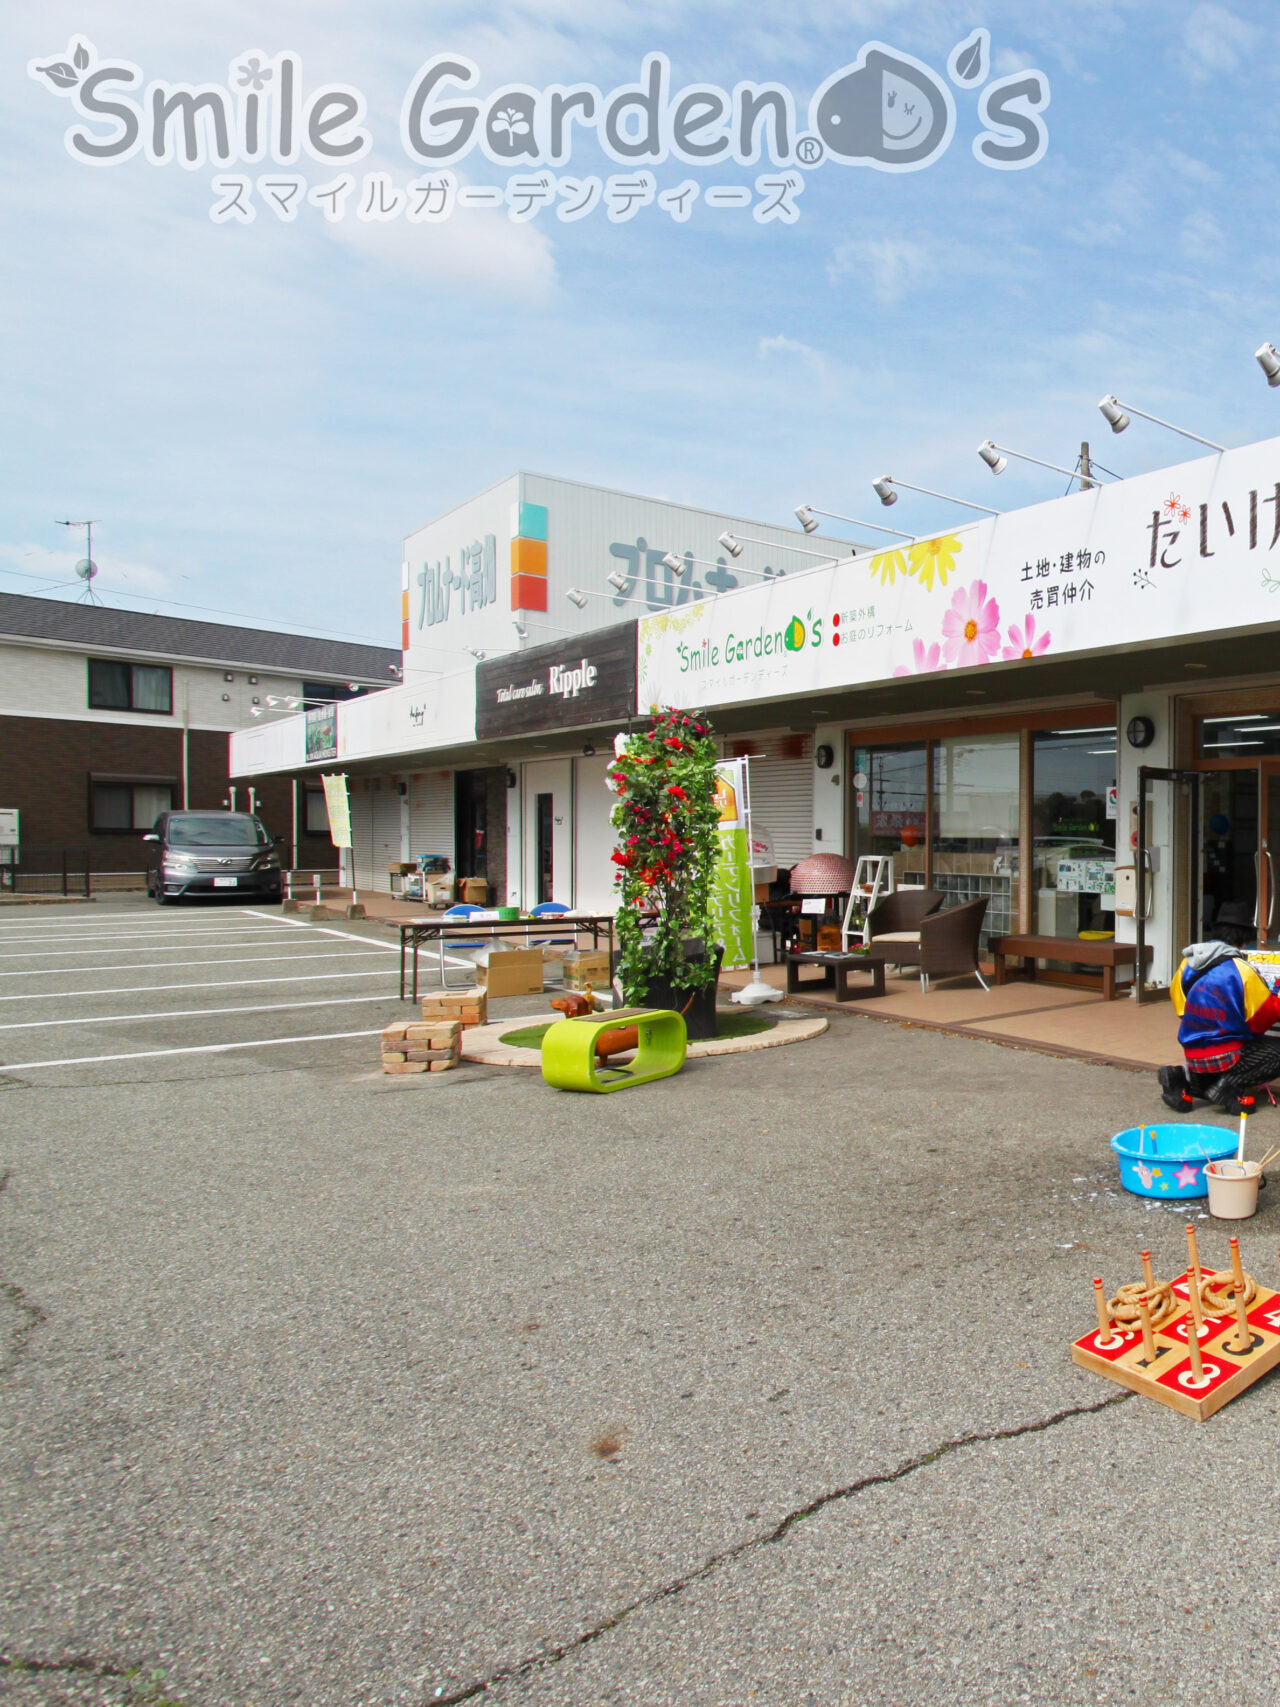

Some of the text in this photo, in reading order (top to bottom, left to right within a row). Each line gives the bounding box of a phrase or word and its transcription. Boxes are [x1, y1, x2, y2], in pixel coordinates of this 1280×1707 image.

[1020, 548, 1106, 582] 土地・建物の
[1030, 578, 1095, 611] 売買仲介
[841, 617, 913, 644] お庭のリフォーム
[679, 639, 719, 672] Smile
[725, 625, 783, 663] Garden
[549, 658, 598, 698] Ripple
